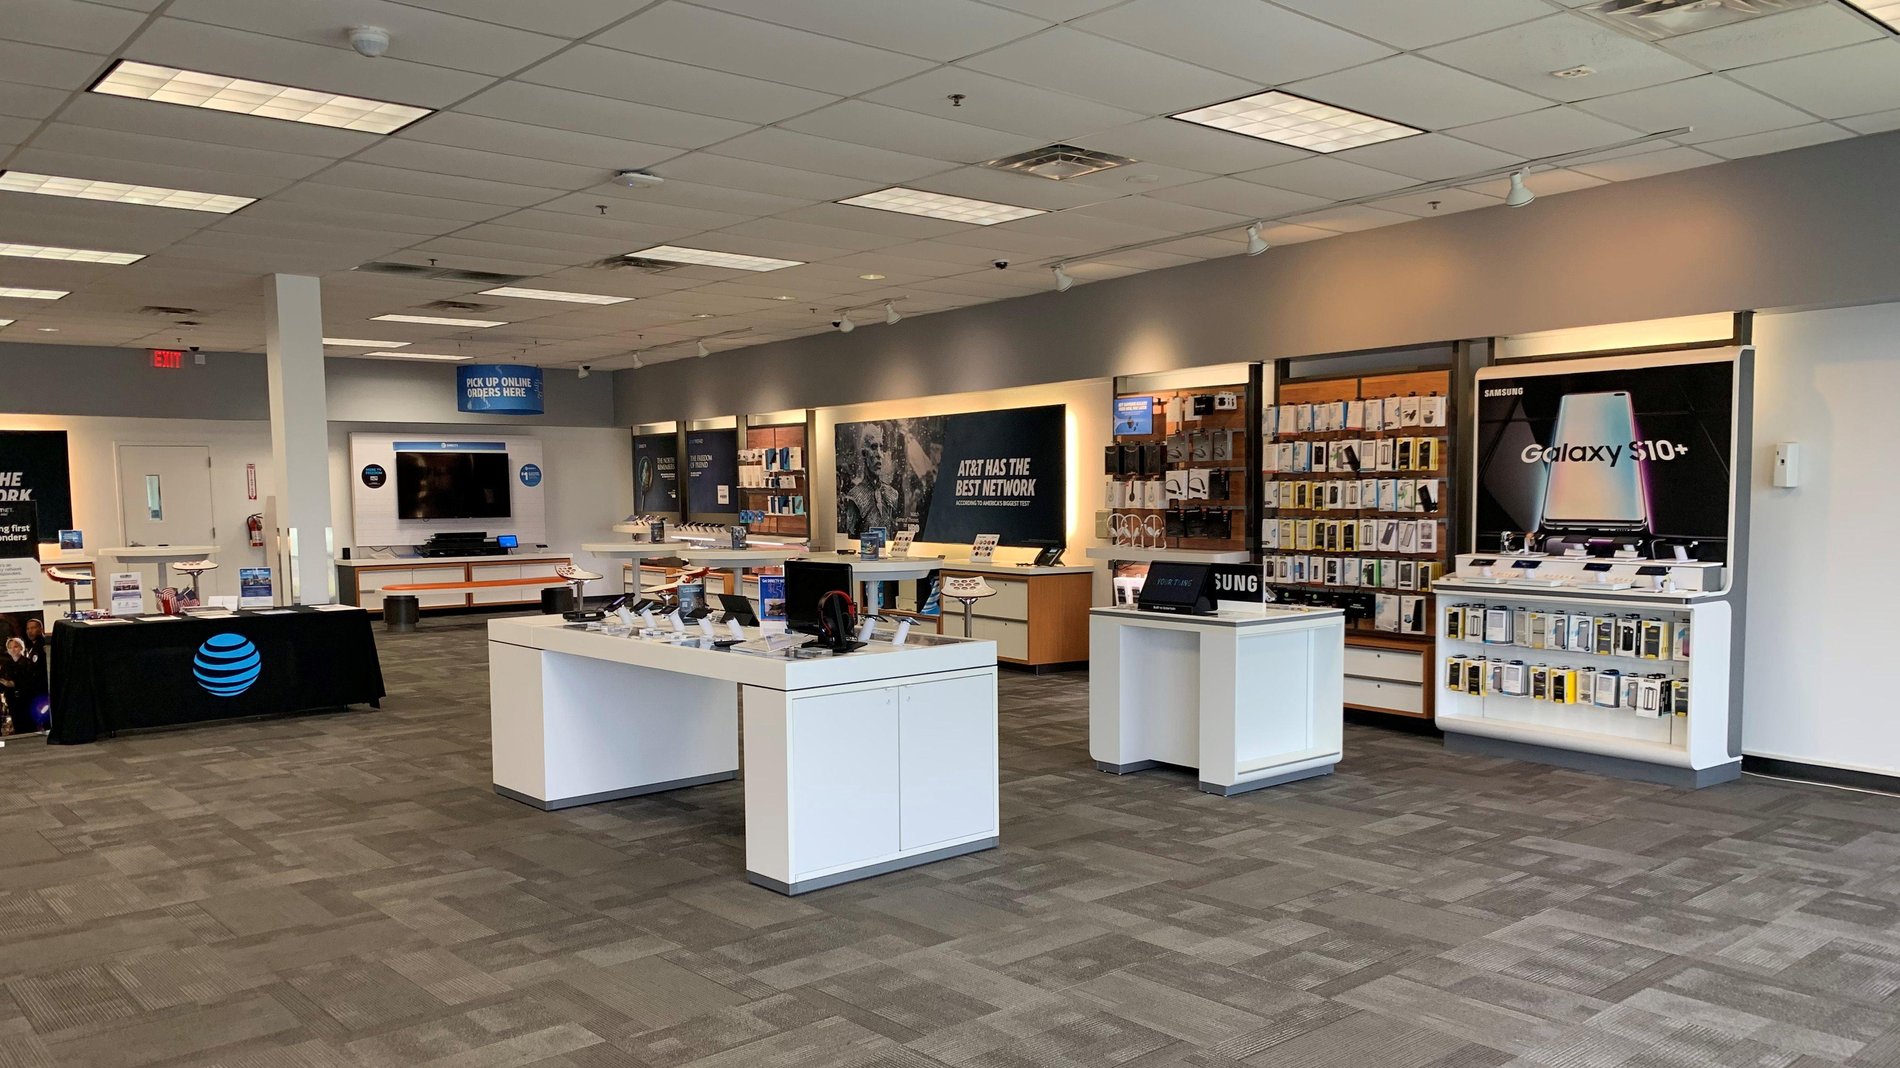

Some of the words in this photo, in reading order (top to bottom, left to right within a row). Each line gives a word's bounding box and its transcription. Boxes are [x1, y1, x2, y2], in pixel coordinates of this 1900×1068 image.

[154, 351, 182, 368] EXIT
[466, 377, 484, 388] PICK
[485, 377, 499, 387] UP
[501, 377, 532, 388] ONLINE
[467, 387, 501, 398] ORDERS
[503, 387, 527, 397] HERE
[1484, 387, 1524, 398] SAMSUNG
[1520, 442, 1623, 468] Galaxy
[1628, 439, 1689, 462] S10+
[957, 459, 984, 476] AT&T
[985, 458, 1006, 476] HAS
[1009, 457, 1031, 476] THE
[0, 471, 23, 486] HE
[955, 479, 982, 497] BEST
[982, 479, 1036, 496] NETWORK
[11, 524, 30, 532] first
[0, 533, 28, 541] onders
[1215, 572, 1258, 593] SUNG
